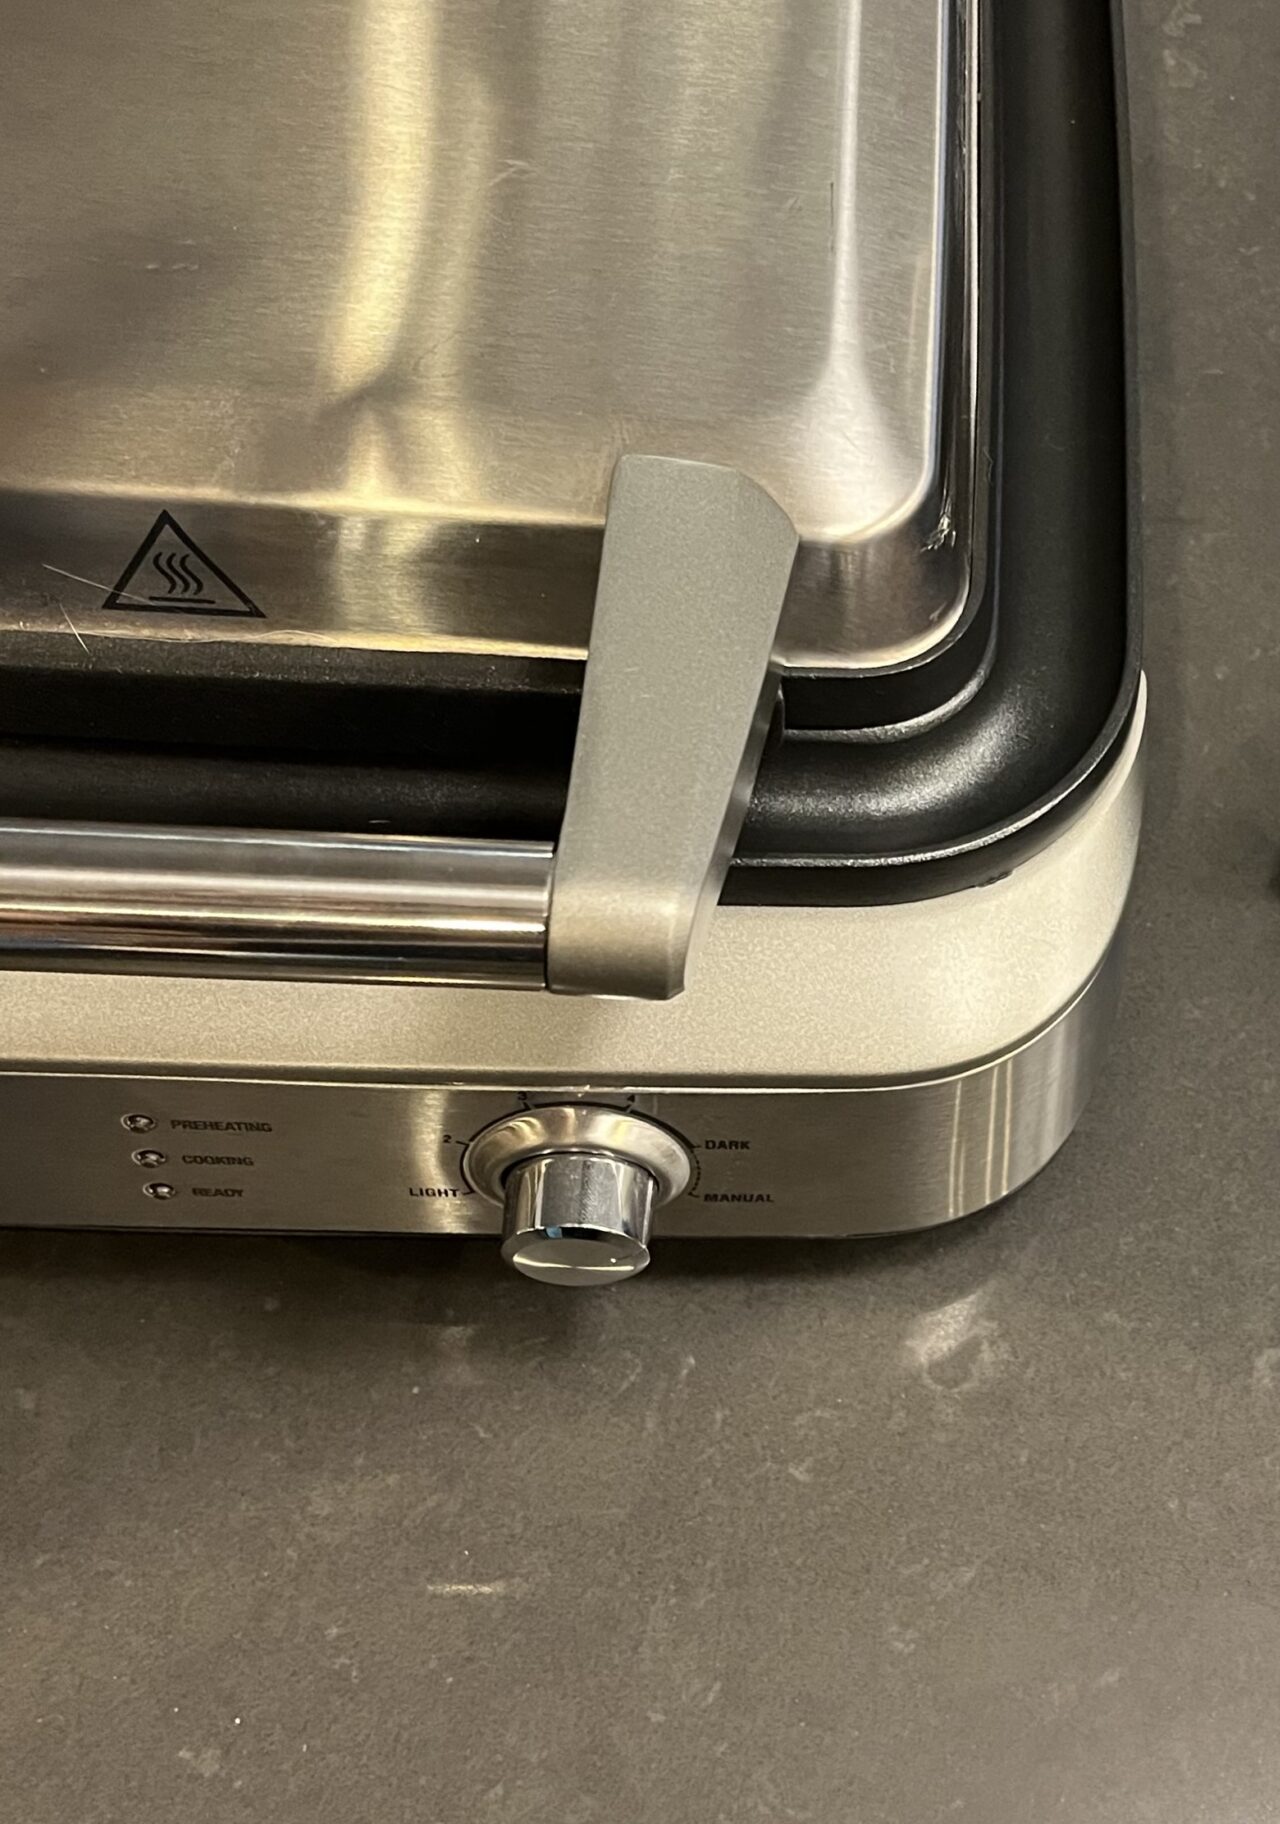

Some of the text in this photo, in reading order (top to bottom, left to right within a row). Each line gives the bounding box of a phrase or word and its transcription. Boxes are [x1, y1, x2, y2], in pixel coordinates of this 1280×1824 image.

[170, 1119, 273, 1133] PREHEATING
[442, 1134, 452, 1143] 2
[705, 1139, 751, 1151] DARK
[182, 1154, 254, 1166] COOKING
[191, 1187, 244, 1198] READY
[408, 1186, 460, 1198] LIGHT
[703, 1193, 775, 1204] MANUAL
